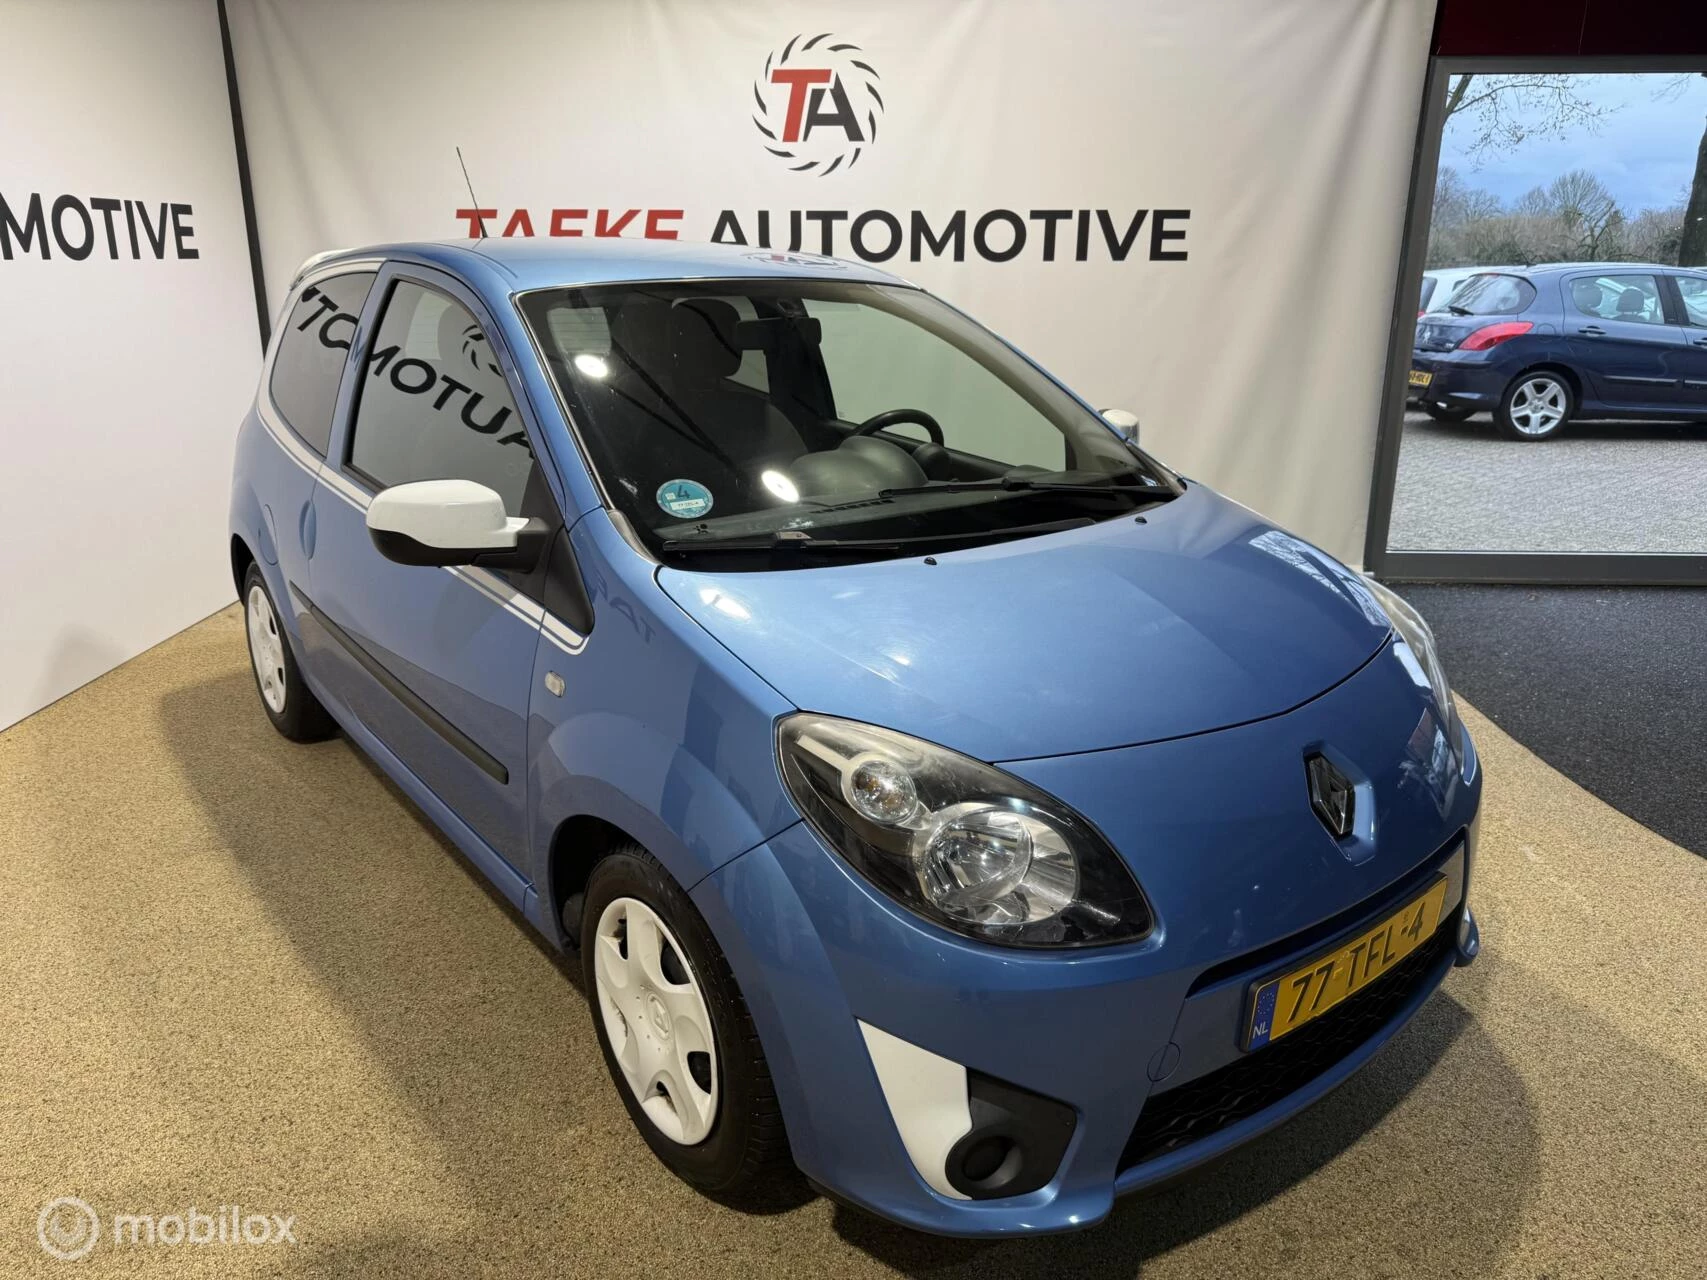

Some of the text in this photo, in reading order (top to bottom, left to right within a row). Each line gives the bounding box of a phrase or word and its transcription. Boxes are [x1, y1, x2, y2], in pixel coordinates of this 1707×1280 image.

[771, 69, 864, 142] TA
[711, 209, 1190, 262] AUTOMOTIVE
[678, 485, 690, 498] 4
[1253, 1022, 1268, 1038] NL
